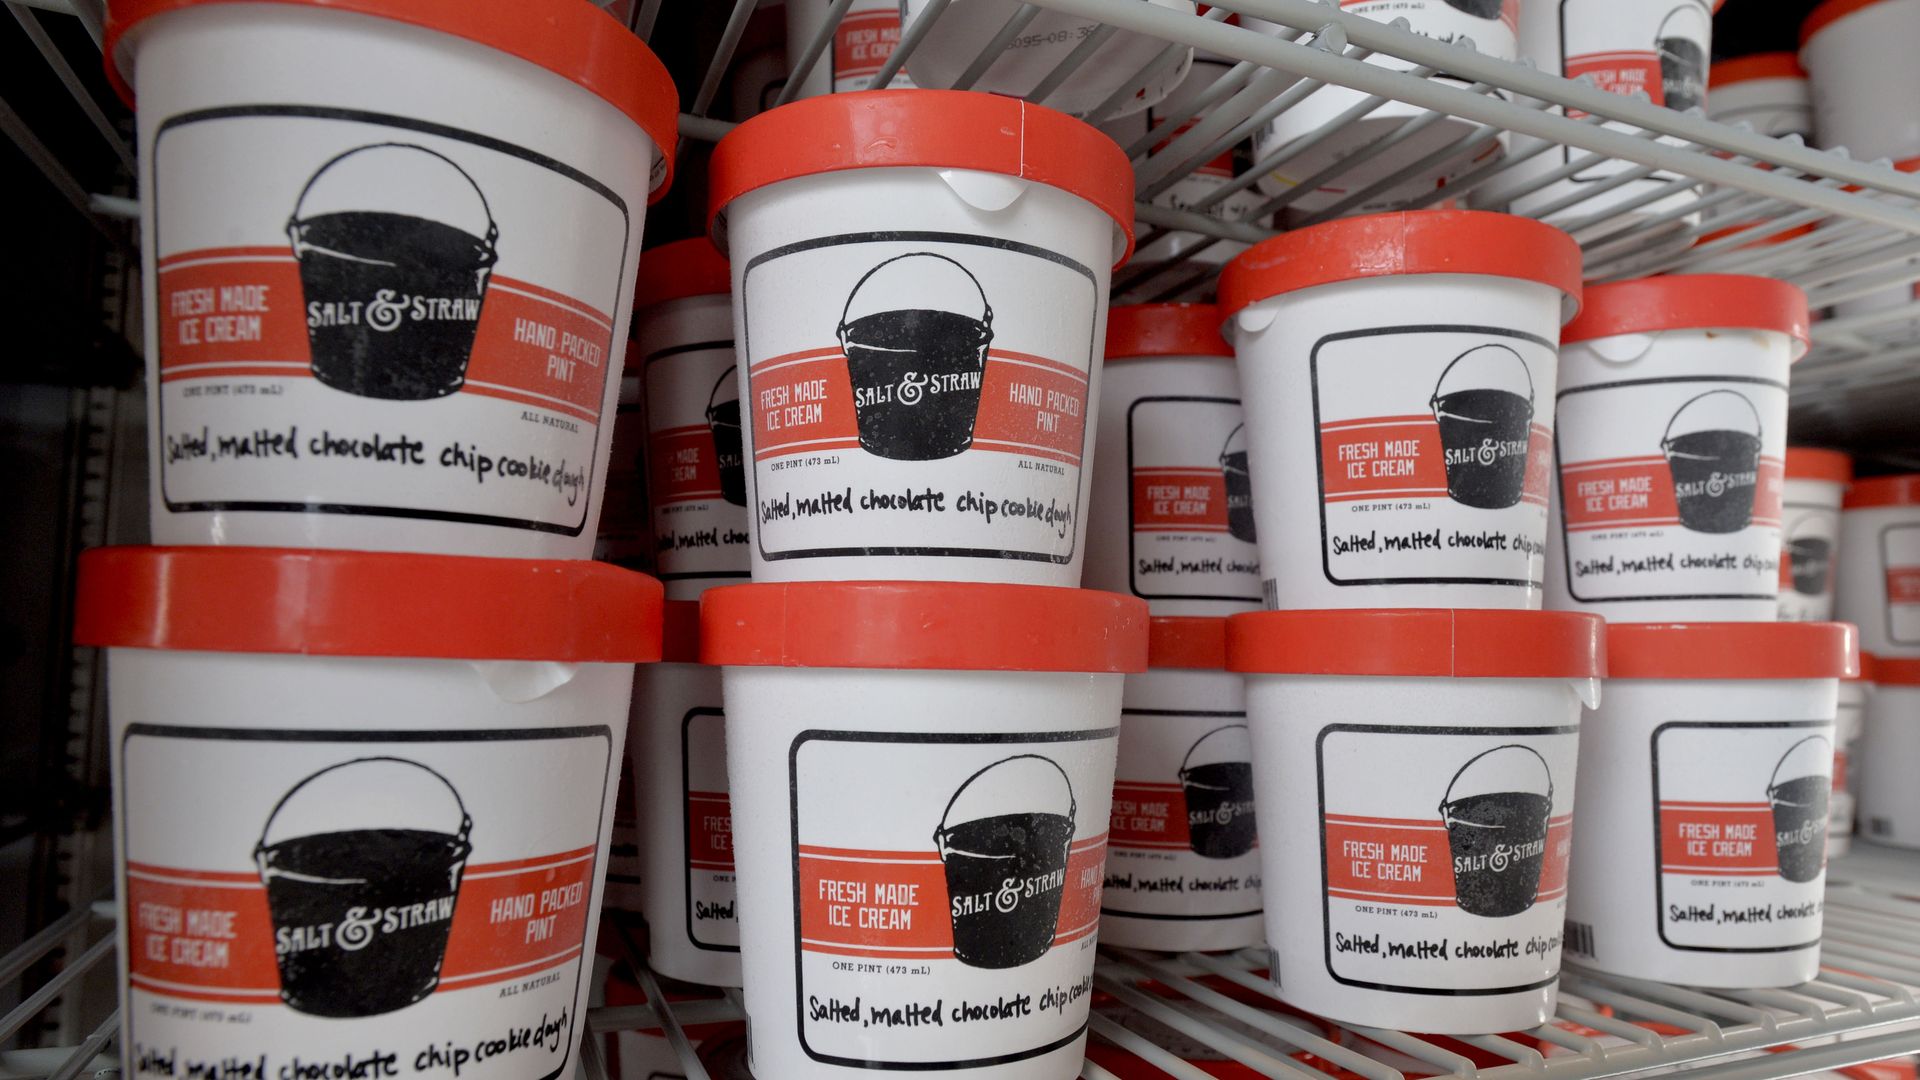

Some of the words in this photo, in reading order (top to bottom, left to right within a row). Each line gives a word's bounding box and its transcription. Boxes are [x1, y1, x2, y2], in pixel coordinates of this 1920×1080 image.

[171, 288, 215, 317] FRESH
[220, 285, 270, 313] MADE
[307, 300, 364, 328] SALT
[364, 288, 411, 332] &
[411, 296, 480, 321] STRAW
[179, 319, 200, 345] ICE
[205, 316, 261, 342] CREAM
[514, 317, 556, 350] HAND
[561, 331, 601, 368] PACKED
[546, 354, 577, 383] PINT
[760, 384, 790, 411] FRESH
[794, 379, 828, 403] MADE
[855, 384, 894, 408] SALT
[896, 371, 929, 406] &
[930, 371, 982, 394] STRAW
[1009, 382, 1042, 407] HAND
[1046, 390, 1080, 417] PACKED
[520, 411, 540, 424] ALL
[542, 416, 579, 434] NATURAL
[767, 410, 781, 431] ICE
[784, 403, 823, 428] CREAM
[1036, 410, 1060, 433] PINT
[218, 425, 298, 460] malted
[309, 430, 425, 465] chocolate
[440, 442, 493, 483] chip
[498, 455, 550, 485] cookie
[1338, 441, 1378, 461] FRESH
[1385, 440, 1420, 457] MADE
[1445, 447, 1476, 466] SALT
[1477, 438, 1500, 466] &
[1499, 440, 1528, 457] STRAW
[770, 461, 784, 472] ONE
[786, 458, 803, 468] PINT
[805, 456, 821, 467] (473
[823, 455, 840, 465] mL)
[1018, 460, 1033, 469] ALL
[1035, 463, 1065, 476] NATURAL
[1347, 461, 1367, 479] ICE
[1372, 459, 1415, 477] CREAM
[1147, 485, 1180, 500] FRESH
[1183, 485, 1211, 500] MADE
[1577, 479, 1615, 498] FRESH
[1619, 476, 1653, 495] MADE
[1675, 480, 1705, 498] SALT
[1706, 471, 1729, 498] &
[796, 487, 853, 517] malted
[860, 488, 945, 513] chocolate
[956, 490, 998, 524] chip
[1001, 497, 1043, 521] cookie
[1153, 502, 1169, 516] ICE
[1173, 501, 1207, 516] CREAM
[1351, 504, 1370, 513] ONE
[1372, 503, 1393, 512] PINT
[1395, 503, 1413, 511] (473
[1415, 502, 1431, 510] mL)
[1585, 497, 1604, 513] ICE
[1608, 494, 1648, 512] CREAM
[1384, 528, 1441, 551] malted
[1448, 530, 1507, 550] chocolate
[1622, 553, 1675, 573] malted
[1680, 553, 1737, 570] chocolate
[1141, 802, 1170, 817] MADE
[1189, 810, 1215, 826] SALT
[1216, 801, 1235, 825] &
[704, 816, 732, 832] FRES
[1131, 817, 1165, 832] CREAM
[1679, 823, 1720, 839] FRESH
[1725, 824, 1757, 840] MADE
[711, 834, 728, 850] ICE
[1343, 840, 1384, 860] FRESH
[1391, 844, 1428, 863] MADE
[1687, 841, 1707, 857] ICE
[1712, 842, 1752, 857] CREAM
[1455, 854, 1487, 874] SALT
[1489, 844, 1513, 872] &
[1513, 839, 1545, 862] STRAW
[1352, 861, 1371, 879] ICE
[1377, 863, 1421, 882] CREAM
[490, 893, 536, 924] HAND
[539, 881, 583, 914] PACKED
[819, 879, 867, 904] FRESH
[875, 883, 919, 906] MADE
[951, 892, 993, 917] SALT
[995, 877, 1025, 913] &
[1024, 867, 1065, 898] STRAW
[138, 902, 182, 933] FRESH
[186, 909, 238, 939] MADE
[828, 904, 851, 927] ICE
[858, 907, 911, 930] CREAM
[1355, 905, 1374, 914] ONE
[1376, 907, 1398, 916] PINT
[1400, 909, 1418, 918] (473
[1421, 911, 1438, 919] mL)
[1722, 904, 1772, 924] malted
[276, 922, 334, 954] SALT
[335, 906, 383, 951] &
[382, 896, 455, 934] STRAW
[525, 915, 557, 944] PINT
[145, 933, 168, 963] ICE
[171, 938, 229, 969] CREAM
[1388, 938, 1448, 961] malted
[1455, 938, 1519, 959] chocolate
[832, 961, 854, 971] ONE
[857, 962, 882, 974] PINT
[886, 965, 907, 975] (473
[911, 966, 931, 975] mL)
[499, 986, 519, 999] ALL
[522, 971, 561, 993] NATURAL
[870, 999, 943, 1027] malted
[952, 993, 1031, 1022] chocolate
[1039, 986, 1068, 1015] chip
[280, 1051, 398, 1080] chocolate
[414, 1040, 470, 1077] chip
[475, 1028, 531, 1062] cookie
